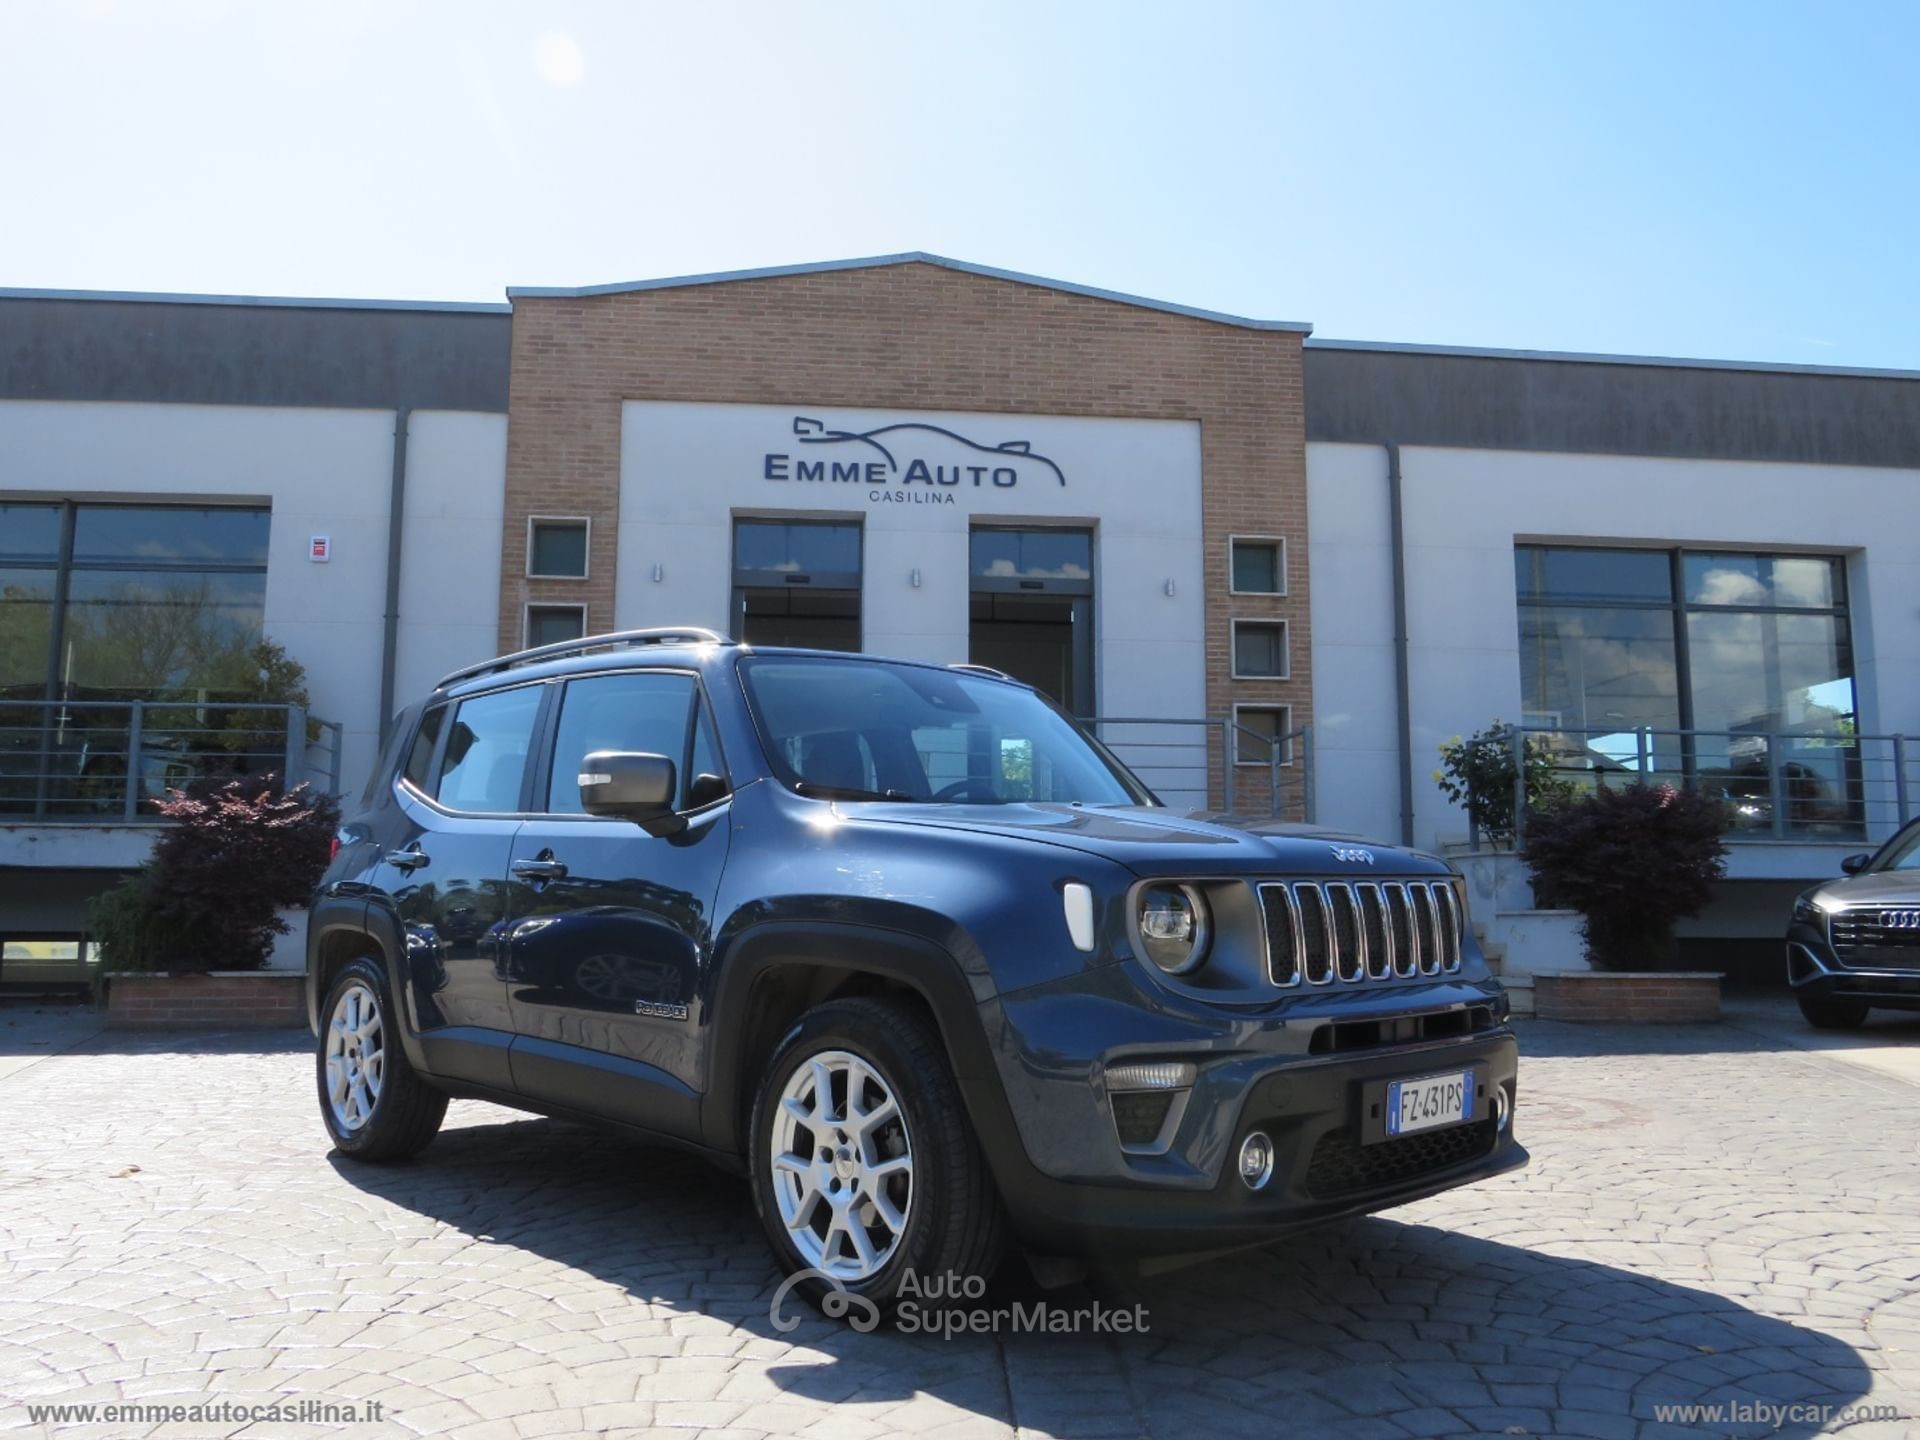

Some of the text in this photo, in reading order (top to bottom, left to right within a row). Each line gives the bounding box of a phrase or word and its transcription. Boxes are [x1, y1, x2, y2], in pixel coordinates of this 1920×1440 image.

[764, 454, 1018, 488] EMME AUTO
[869, 490, 955, 505] CASILINA
